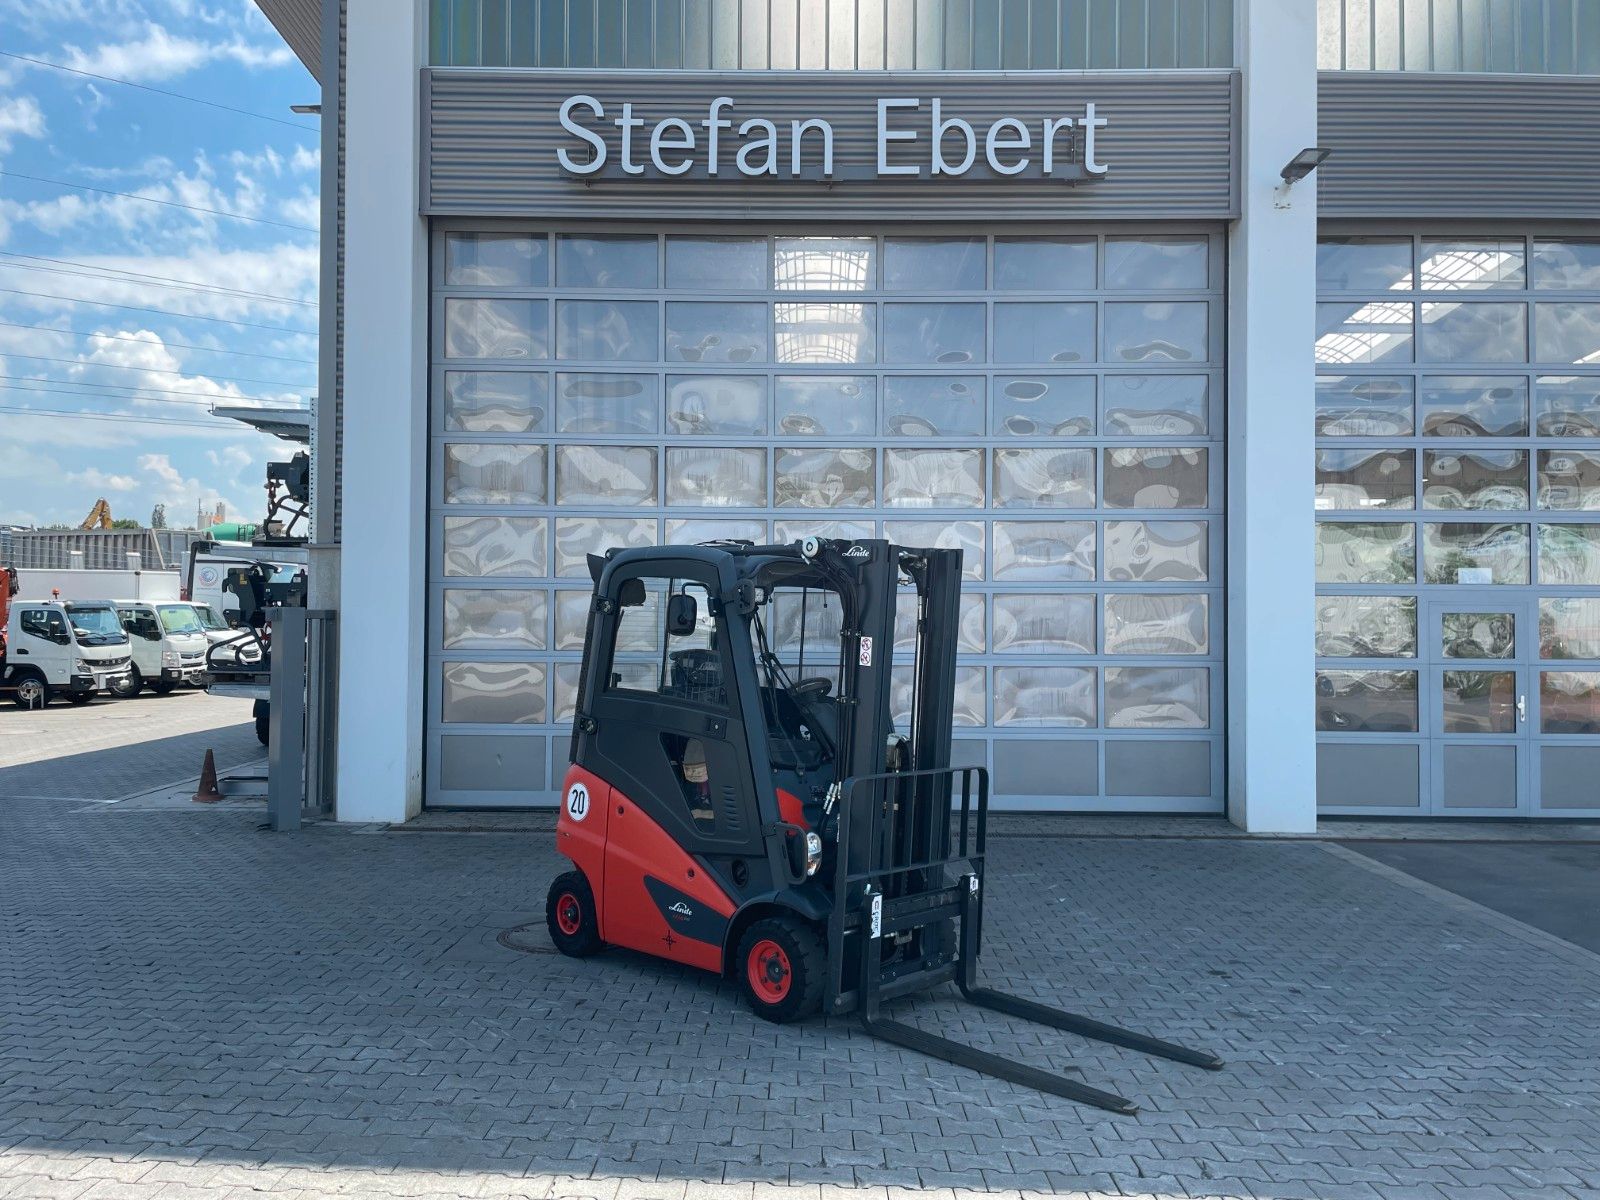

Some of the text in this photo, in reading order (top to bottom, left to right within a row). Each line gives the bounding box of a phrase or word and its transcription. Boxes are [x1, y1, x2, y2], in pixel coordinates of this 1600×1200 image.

[556, 94, 1109, 176] Stefan Ebert
[841, 545, 869, 557] Linde
[571, 789, 585, 814] 20
[668, 902, 692, 915] Linde
